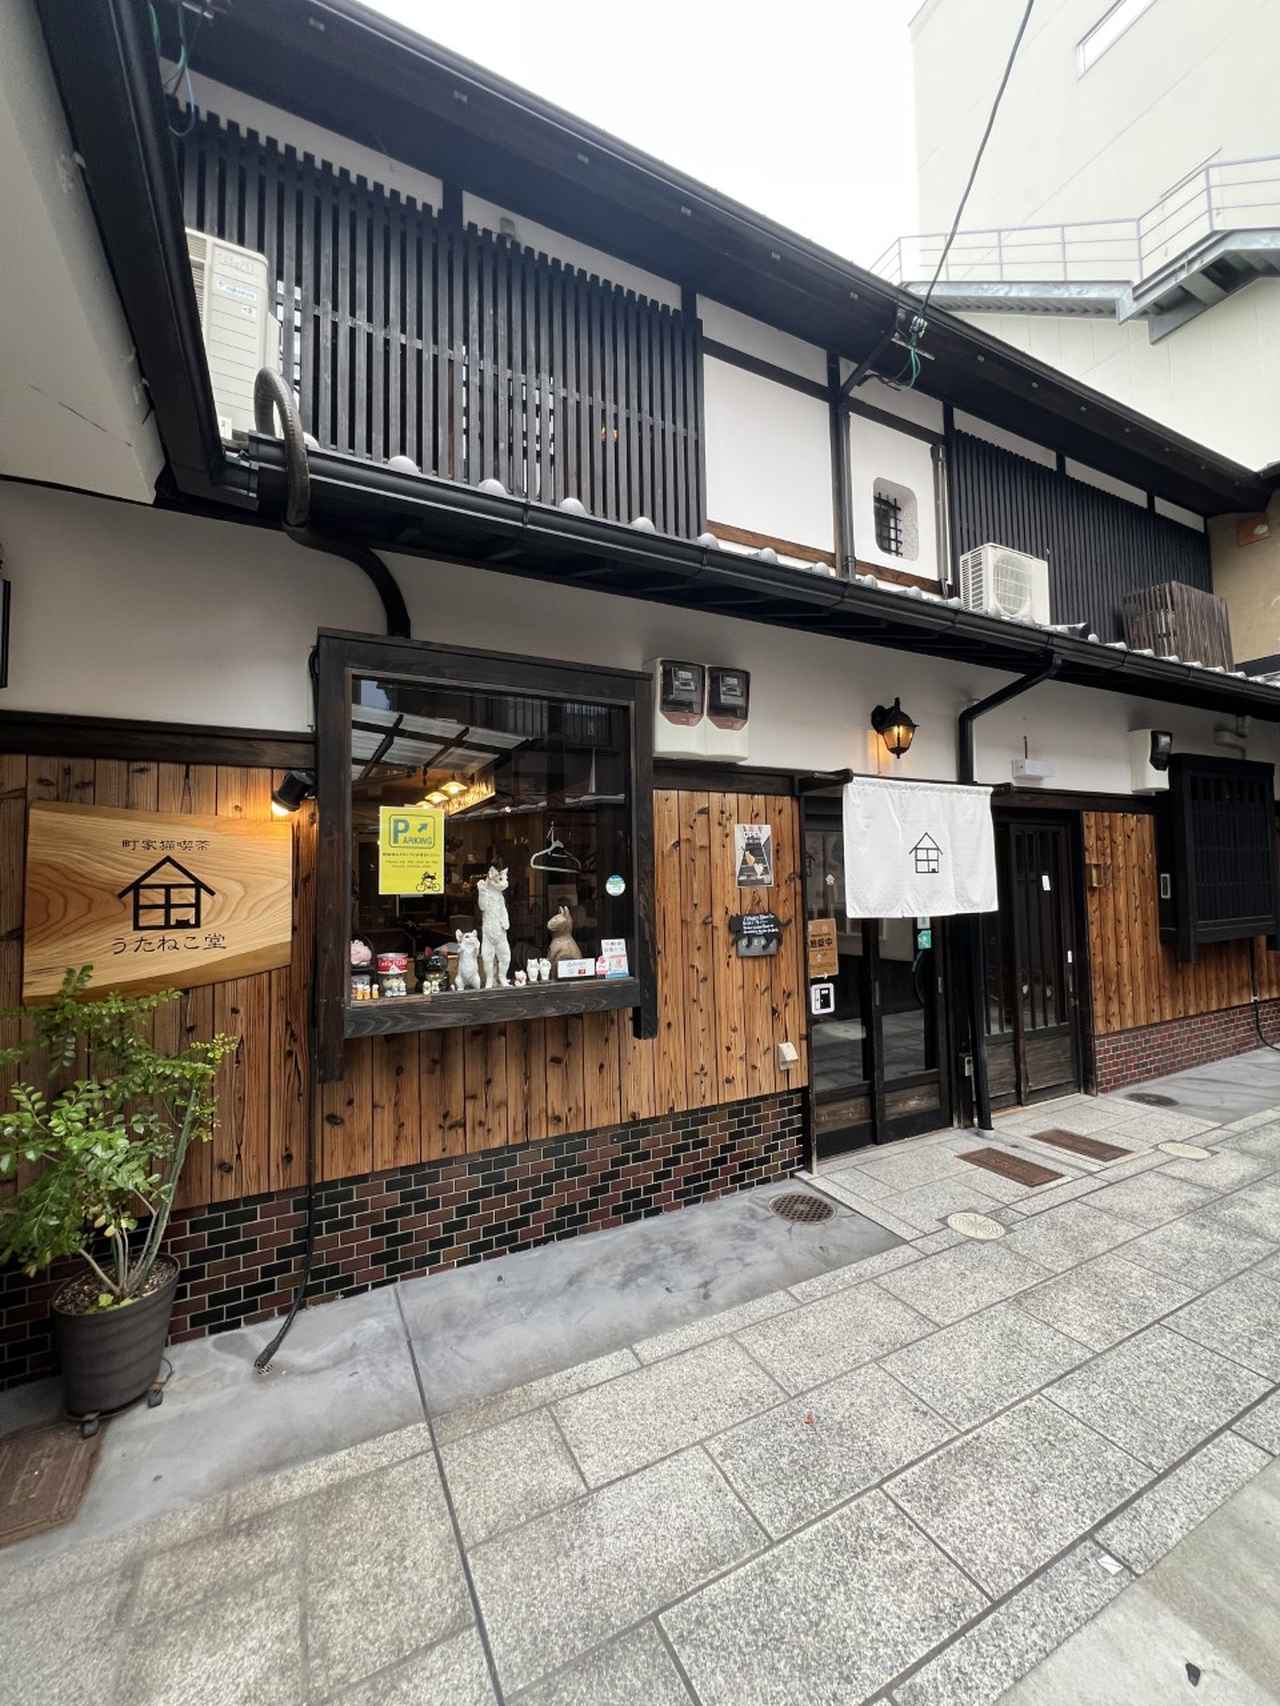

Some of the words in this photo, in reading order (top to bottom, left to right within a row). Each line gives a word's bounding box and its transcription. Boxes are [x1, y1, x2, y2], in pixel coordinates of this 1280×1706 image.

[393, 819, 433, 845] PARKING
[122, 839, 210, 851] 町家猫喫茶
[111, 933, 227, 955] うたねこ堂
